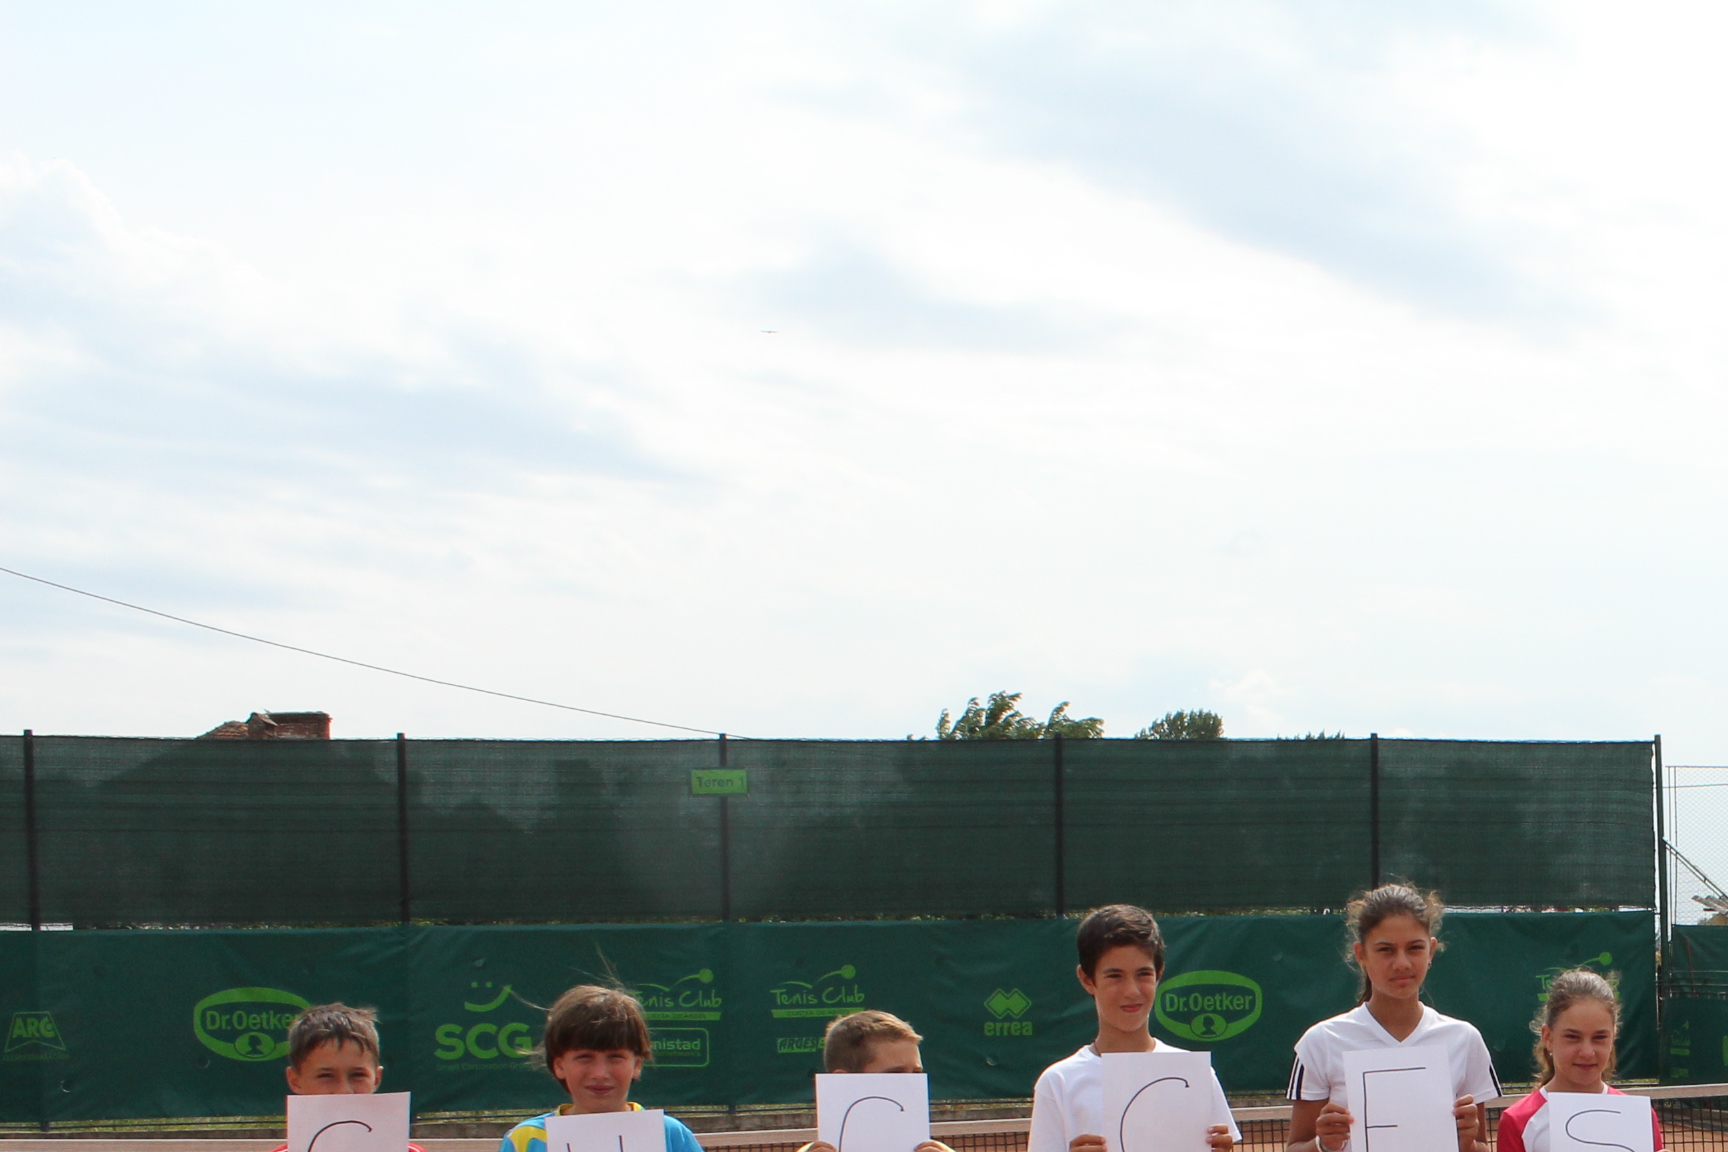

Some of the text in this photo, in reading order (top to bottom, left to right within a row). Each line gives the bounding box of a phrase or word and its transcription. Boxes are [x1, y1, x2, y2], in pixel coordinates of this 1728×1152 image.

[696, 776, 734, 787] Teren
[635, 989, 722, 1008] enis Club
[769, 984, 865, 1005] Tenis Club
[984, 1021, 1033, 1036] errea
[434, 1022, 533, 1060] SCG
